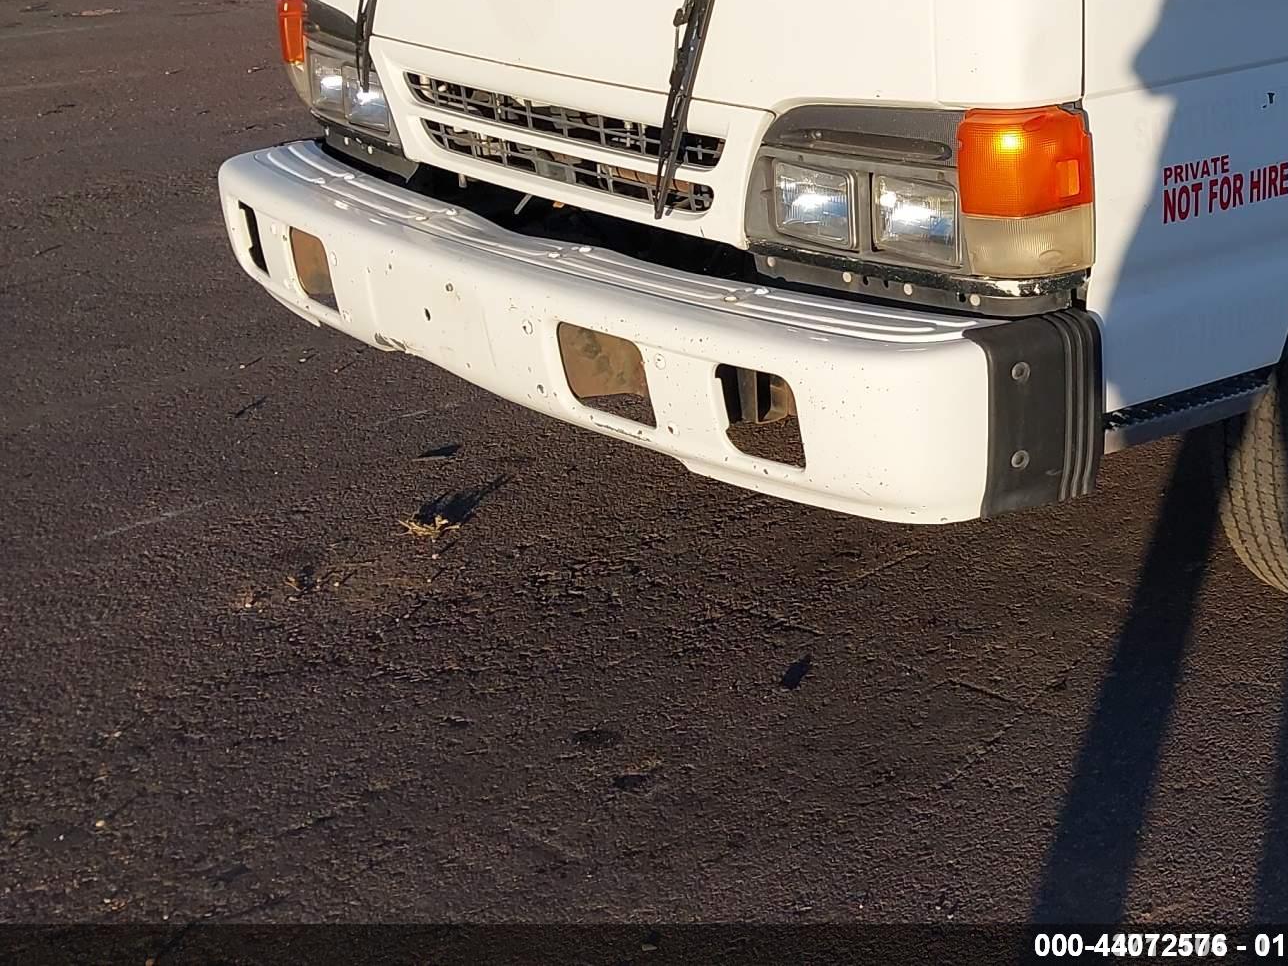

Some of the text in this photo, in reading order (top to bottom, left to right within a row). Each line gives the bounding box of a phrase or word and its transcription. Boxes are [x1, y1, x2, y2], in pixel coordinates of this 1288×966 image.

[1163, 162, 1288, 224] NOT FOR HIRE
[1164, 155, 1229, 186] PRIVATE
